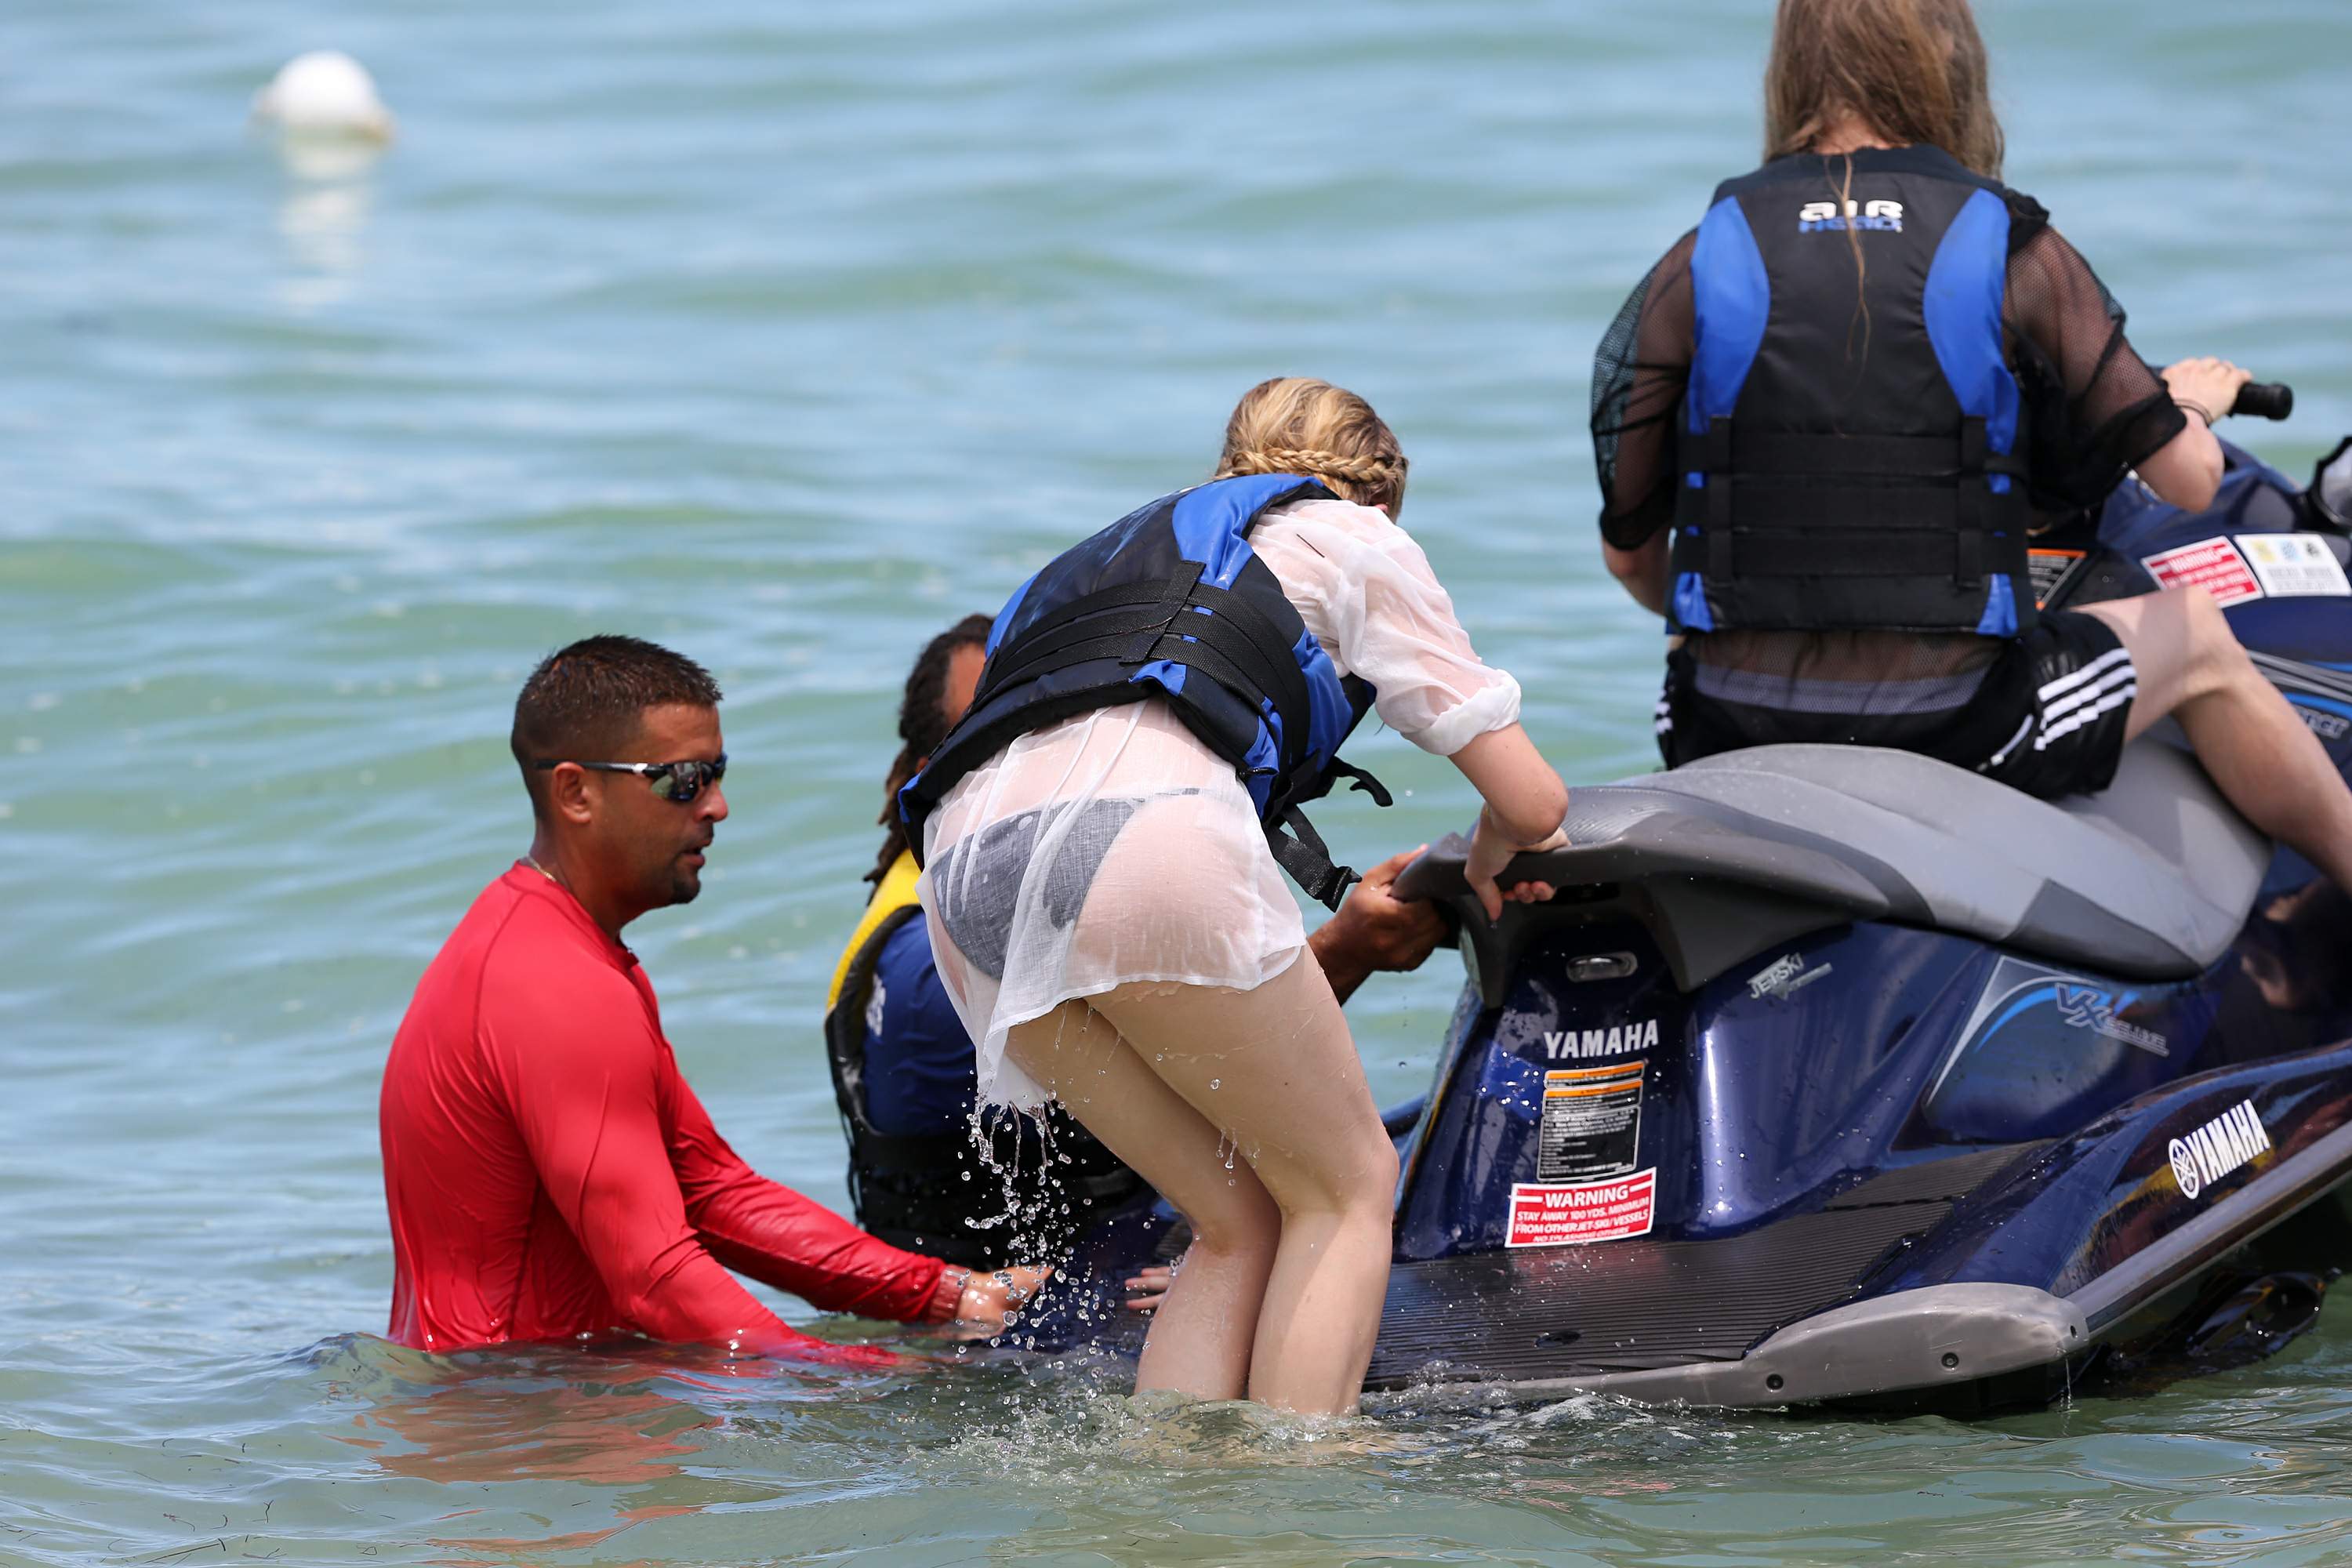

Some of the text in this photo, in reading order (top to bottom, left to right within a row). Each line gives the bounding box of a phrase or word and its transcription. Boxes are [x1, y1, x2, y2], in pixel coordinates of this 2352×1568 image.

[1543, 1019, 1659, 1059] YAMAHA
[2184, 1098, 2270, 1185] YAMAHA
[1516, 1210, 1539, 1221] STAY
[1541, 1210, 1569, 1221] AWAY
[1570, 1209, 1586, 1220] 100
[1609, 1196, 1650, 1214] MINIMUM
[1545, 1185, 1628, 1208] WARNING
[1515, 1223, 1543, 1234] FROM
[1544, 1220, 1577, 1233] OTHER
[1613, 1209, 1648, 1225] VESSELS
